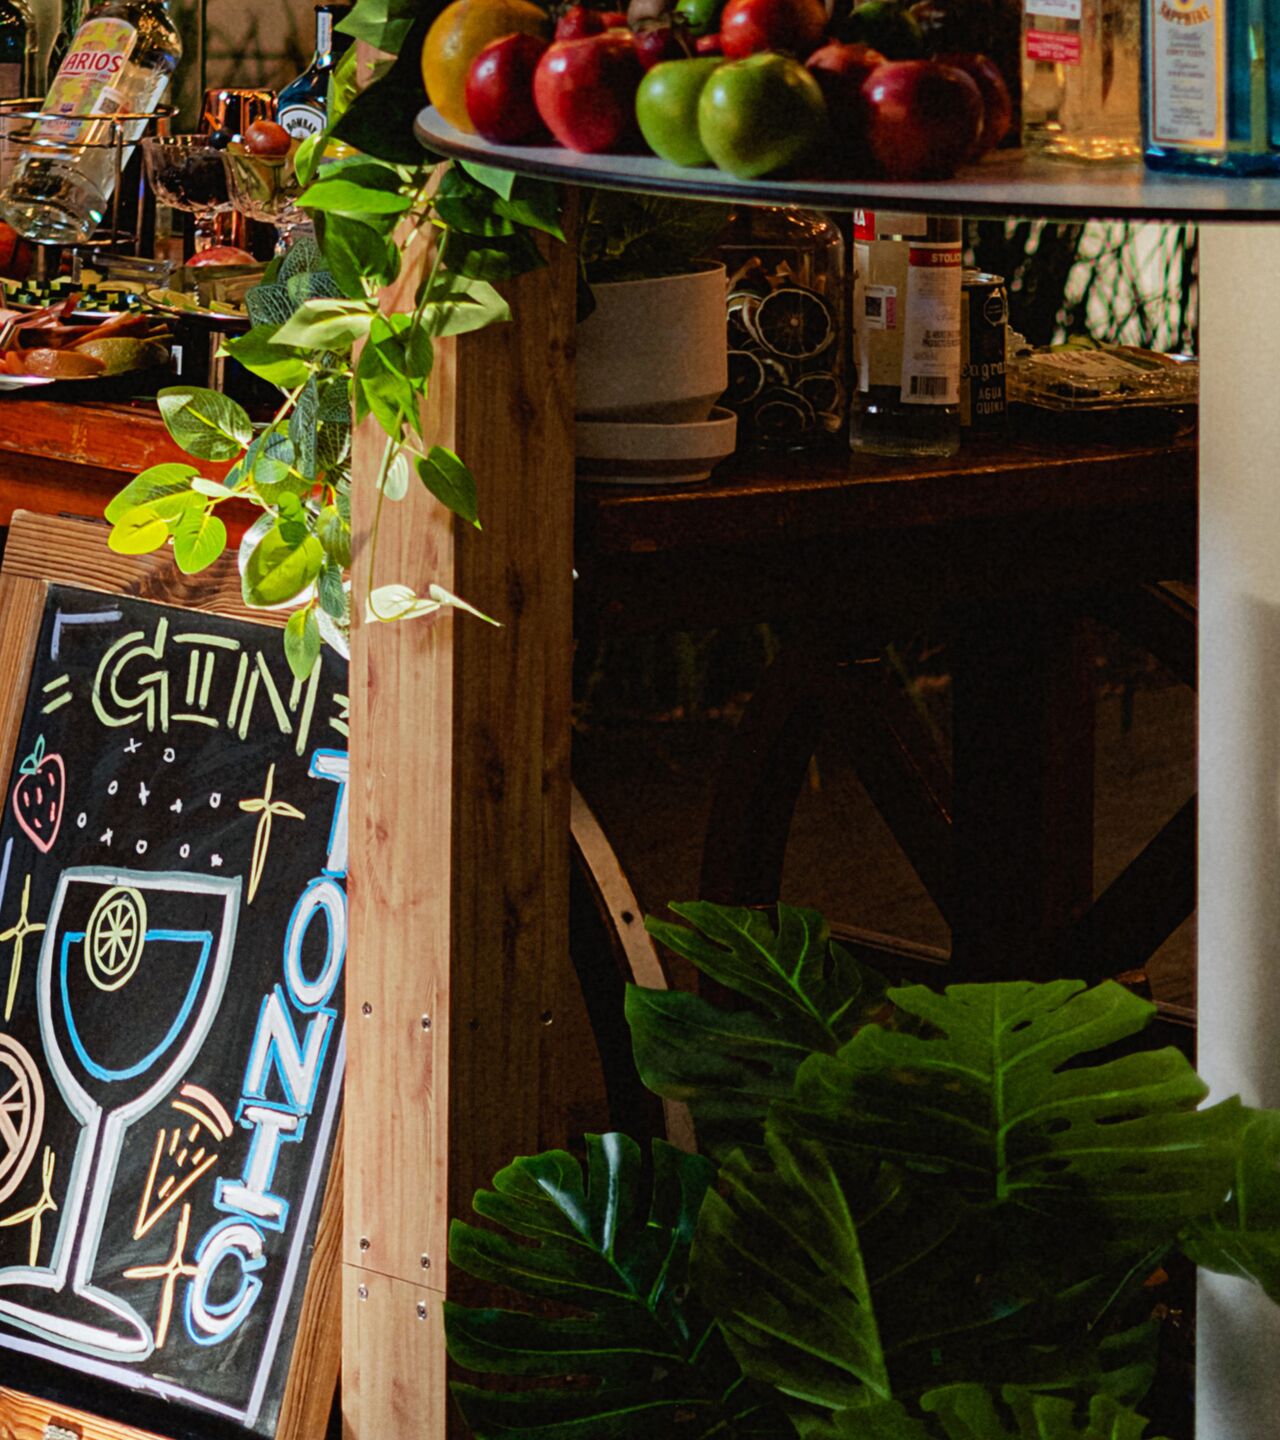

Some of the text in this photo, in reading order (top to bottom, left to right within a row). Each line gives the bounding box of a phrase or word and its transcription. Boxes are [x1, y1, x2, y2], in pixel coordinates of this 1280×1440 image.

[286, 117, 317, 134] BOMBAY
[92, 616, 323, 756] GIN
[184, 747, 349, 1346] TONIC
